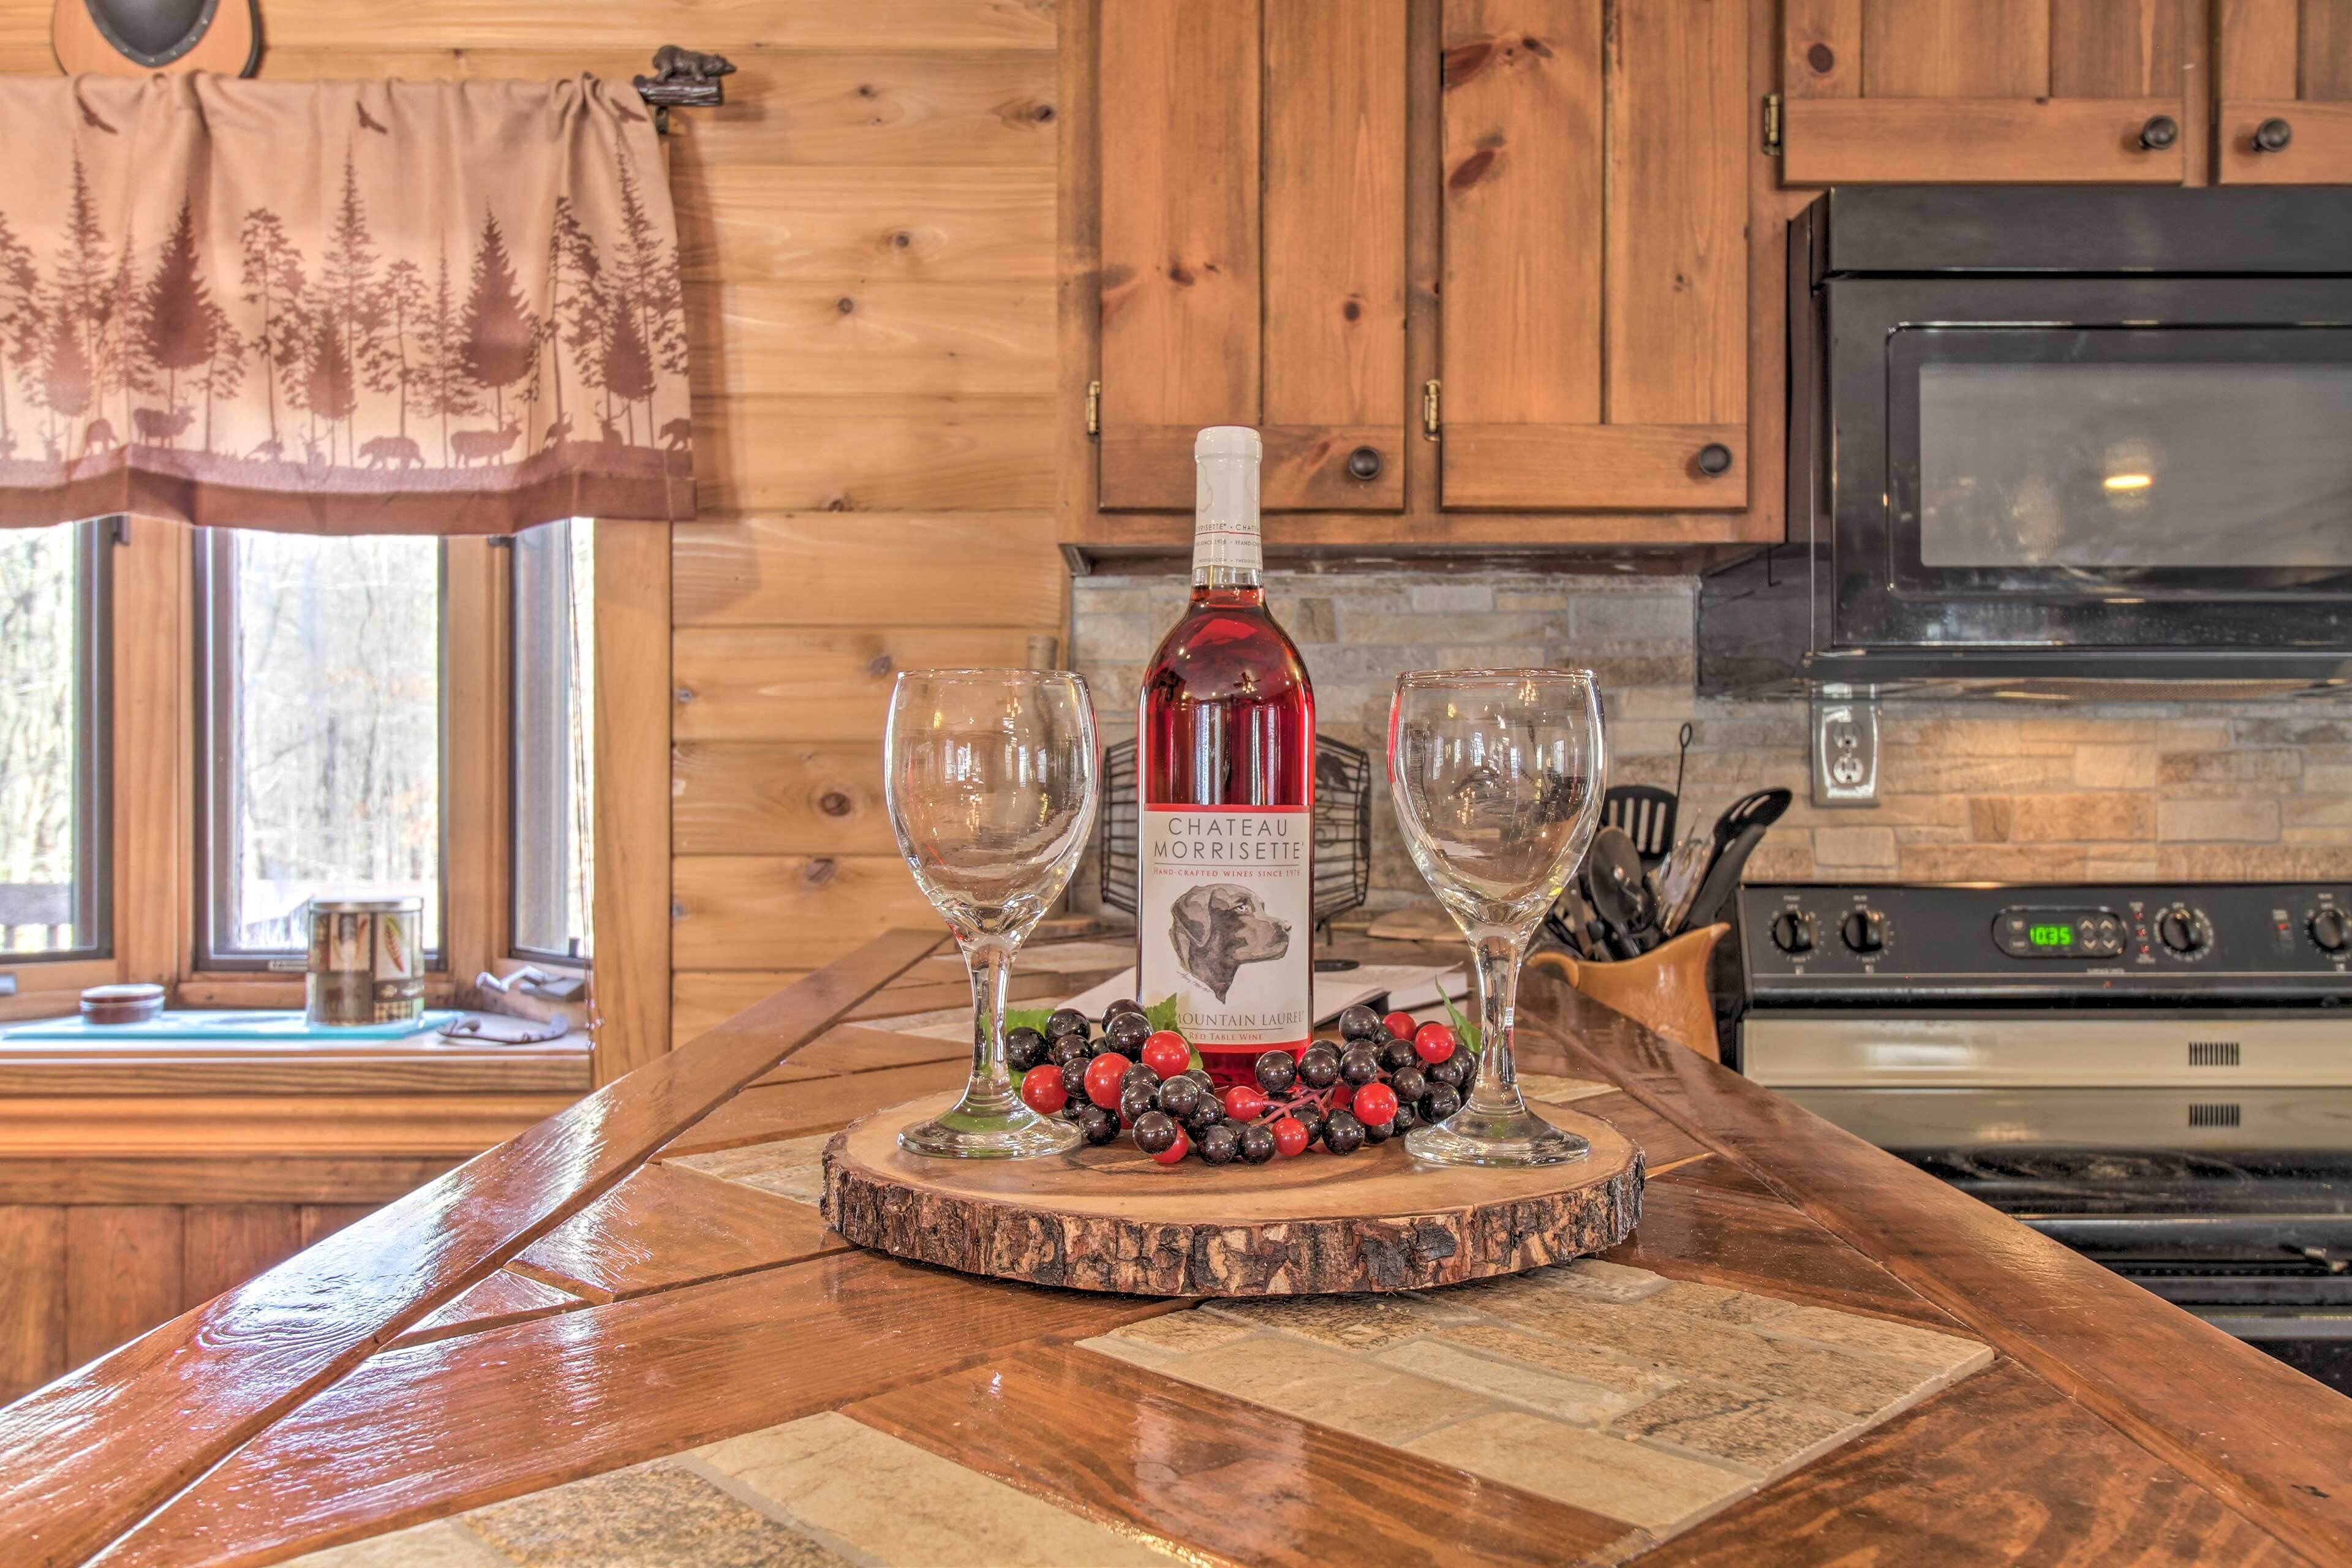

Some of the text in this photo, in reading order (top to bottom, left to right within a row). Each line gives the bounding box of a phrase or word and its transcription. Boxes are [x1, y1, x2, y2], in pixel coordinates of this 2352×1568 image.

[1168, 817, 1287, 837] CHATEAU
[1154, 840, 1300, 859] MORRISETTE
[1153, 867, 1218, 877] HAND-CRAFTED
[1286, 869, 1300, 877] 1978
[1262, 1011, 1303, 1026] LAUREL
